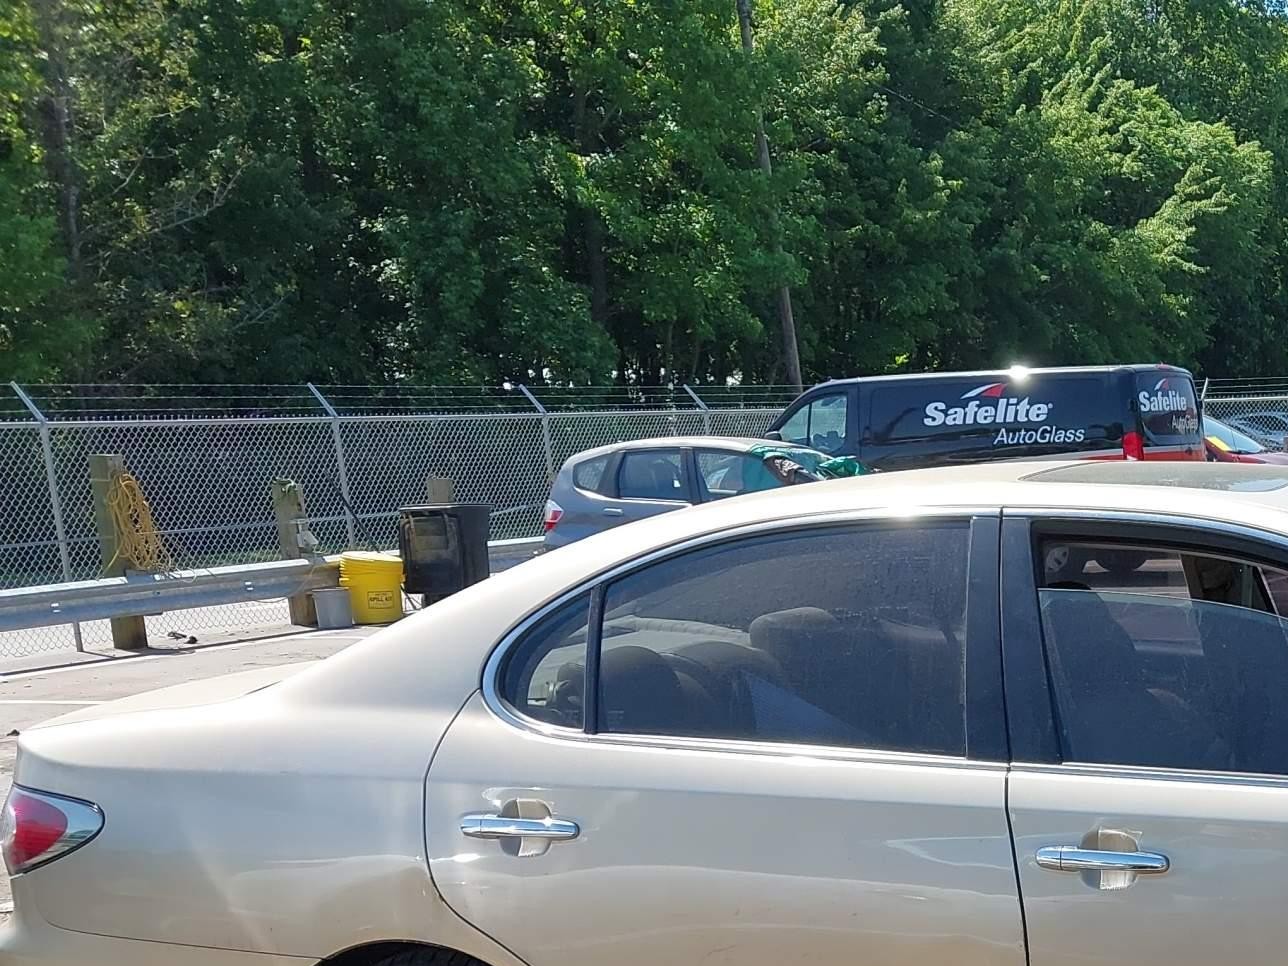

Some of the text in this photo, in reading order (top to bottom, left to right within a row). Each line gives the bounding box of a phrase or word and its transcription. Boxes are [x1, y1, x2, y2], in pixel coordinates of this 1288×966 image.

[923, 397, 1049, 426] Safelite
[1138, 390, 1187, 412] Safelite
[993, 425, 1085, 445] AutoGlass
